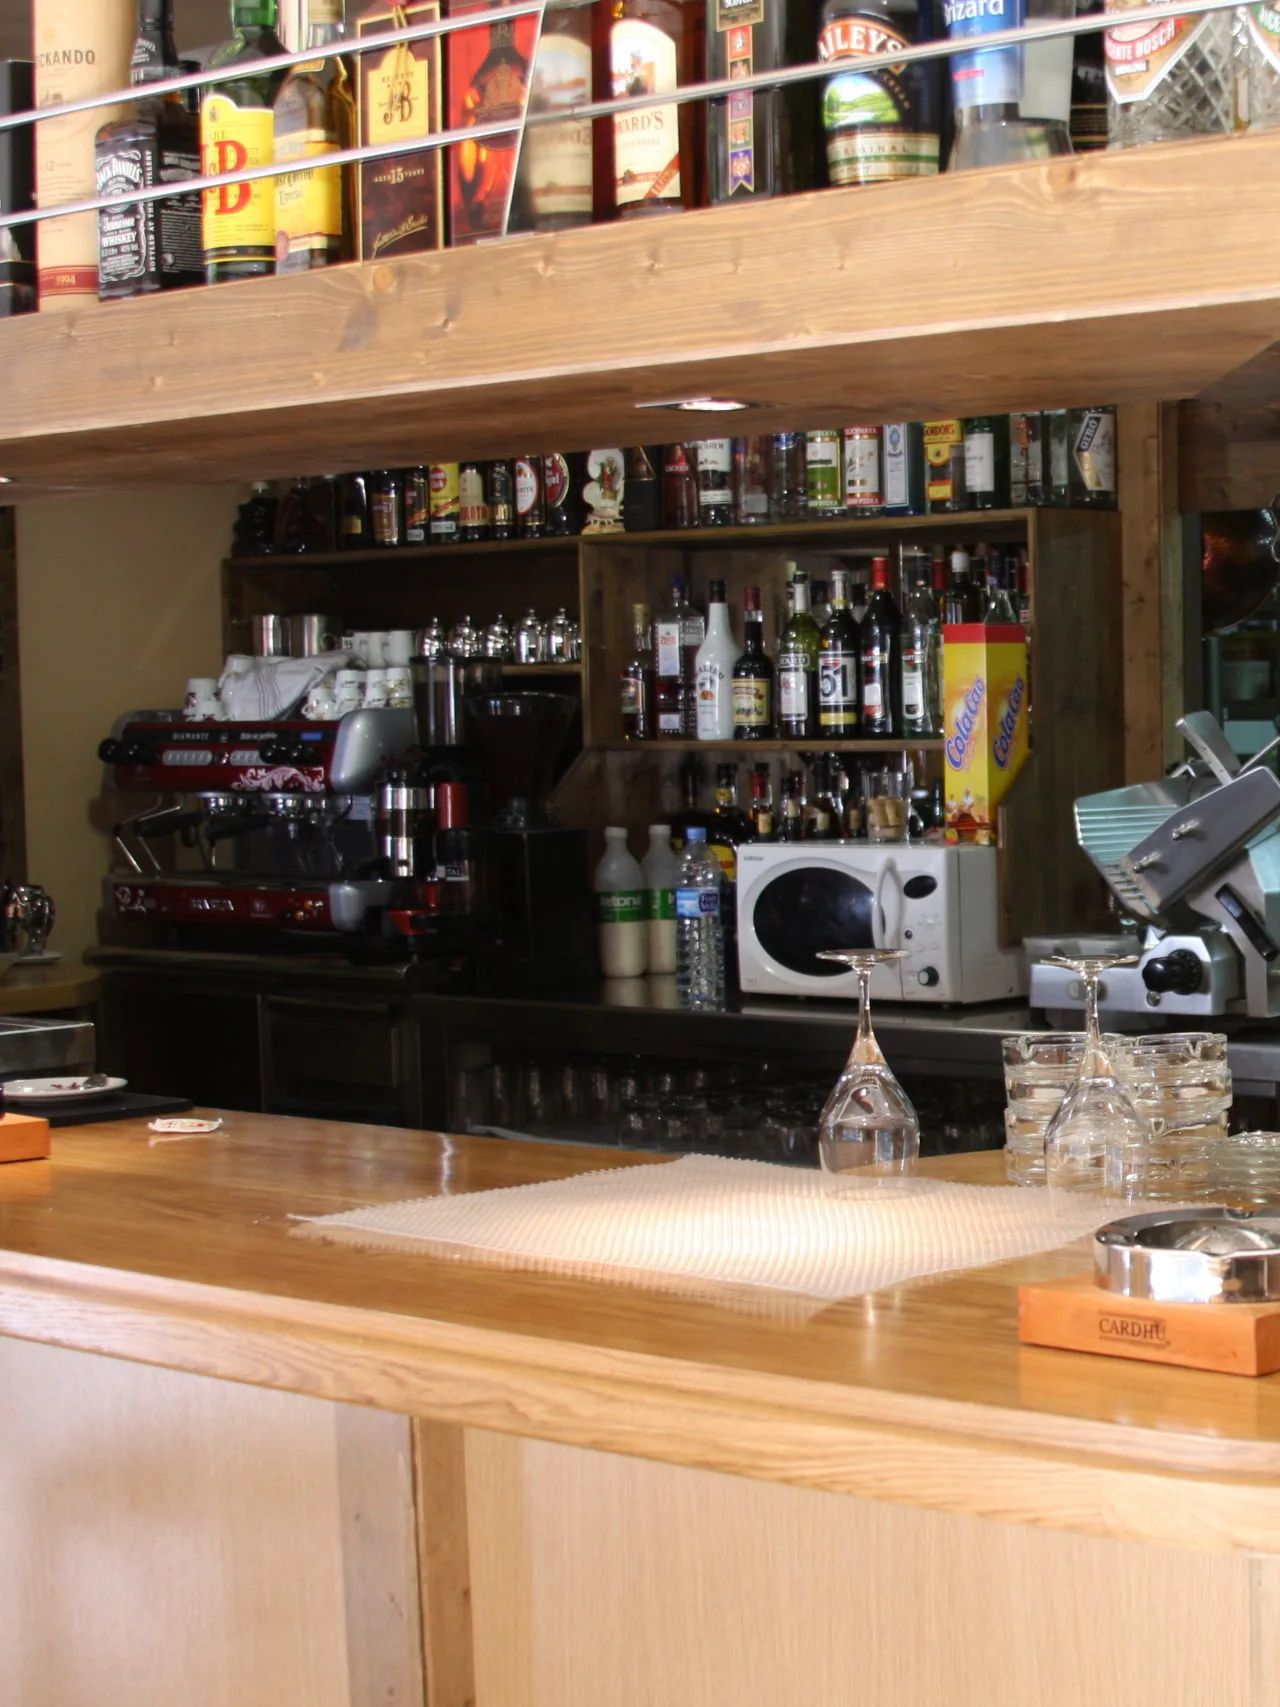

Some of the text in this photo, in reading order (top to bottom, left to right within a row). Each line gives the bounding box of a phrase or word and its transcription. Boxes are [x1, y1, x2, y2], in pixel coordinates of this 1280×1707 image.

[1135, 17, 1175, 58] BOSCH
[391, 167, 404, 184] 15
[102, 231, 137, 248] WHISKEY
[820, 665, 848, 698] 51
[1099, 1318, 1166, 1341] CARDHU
